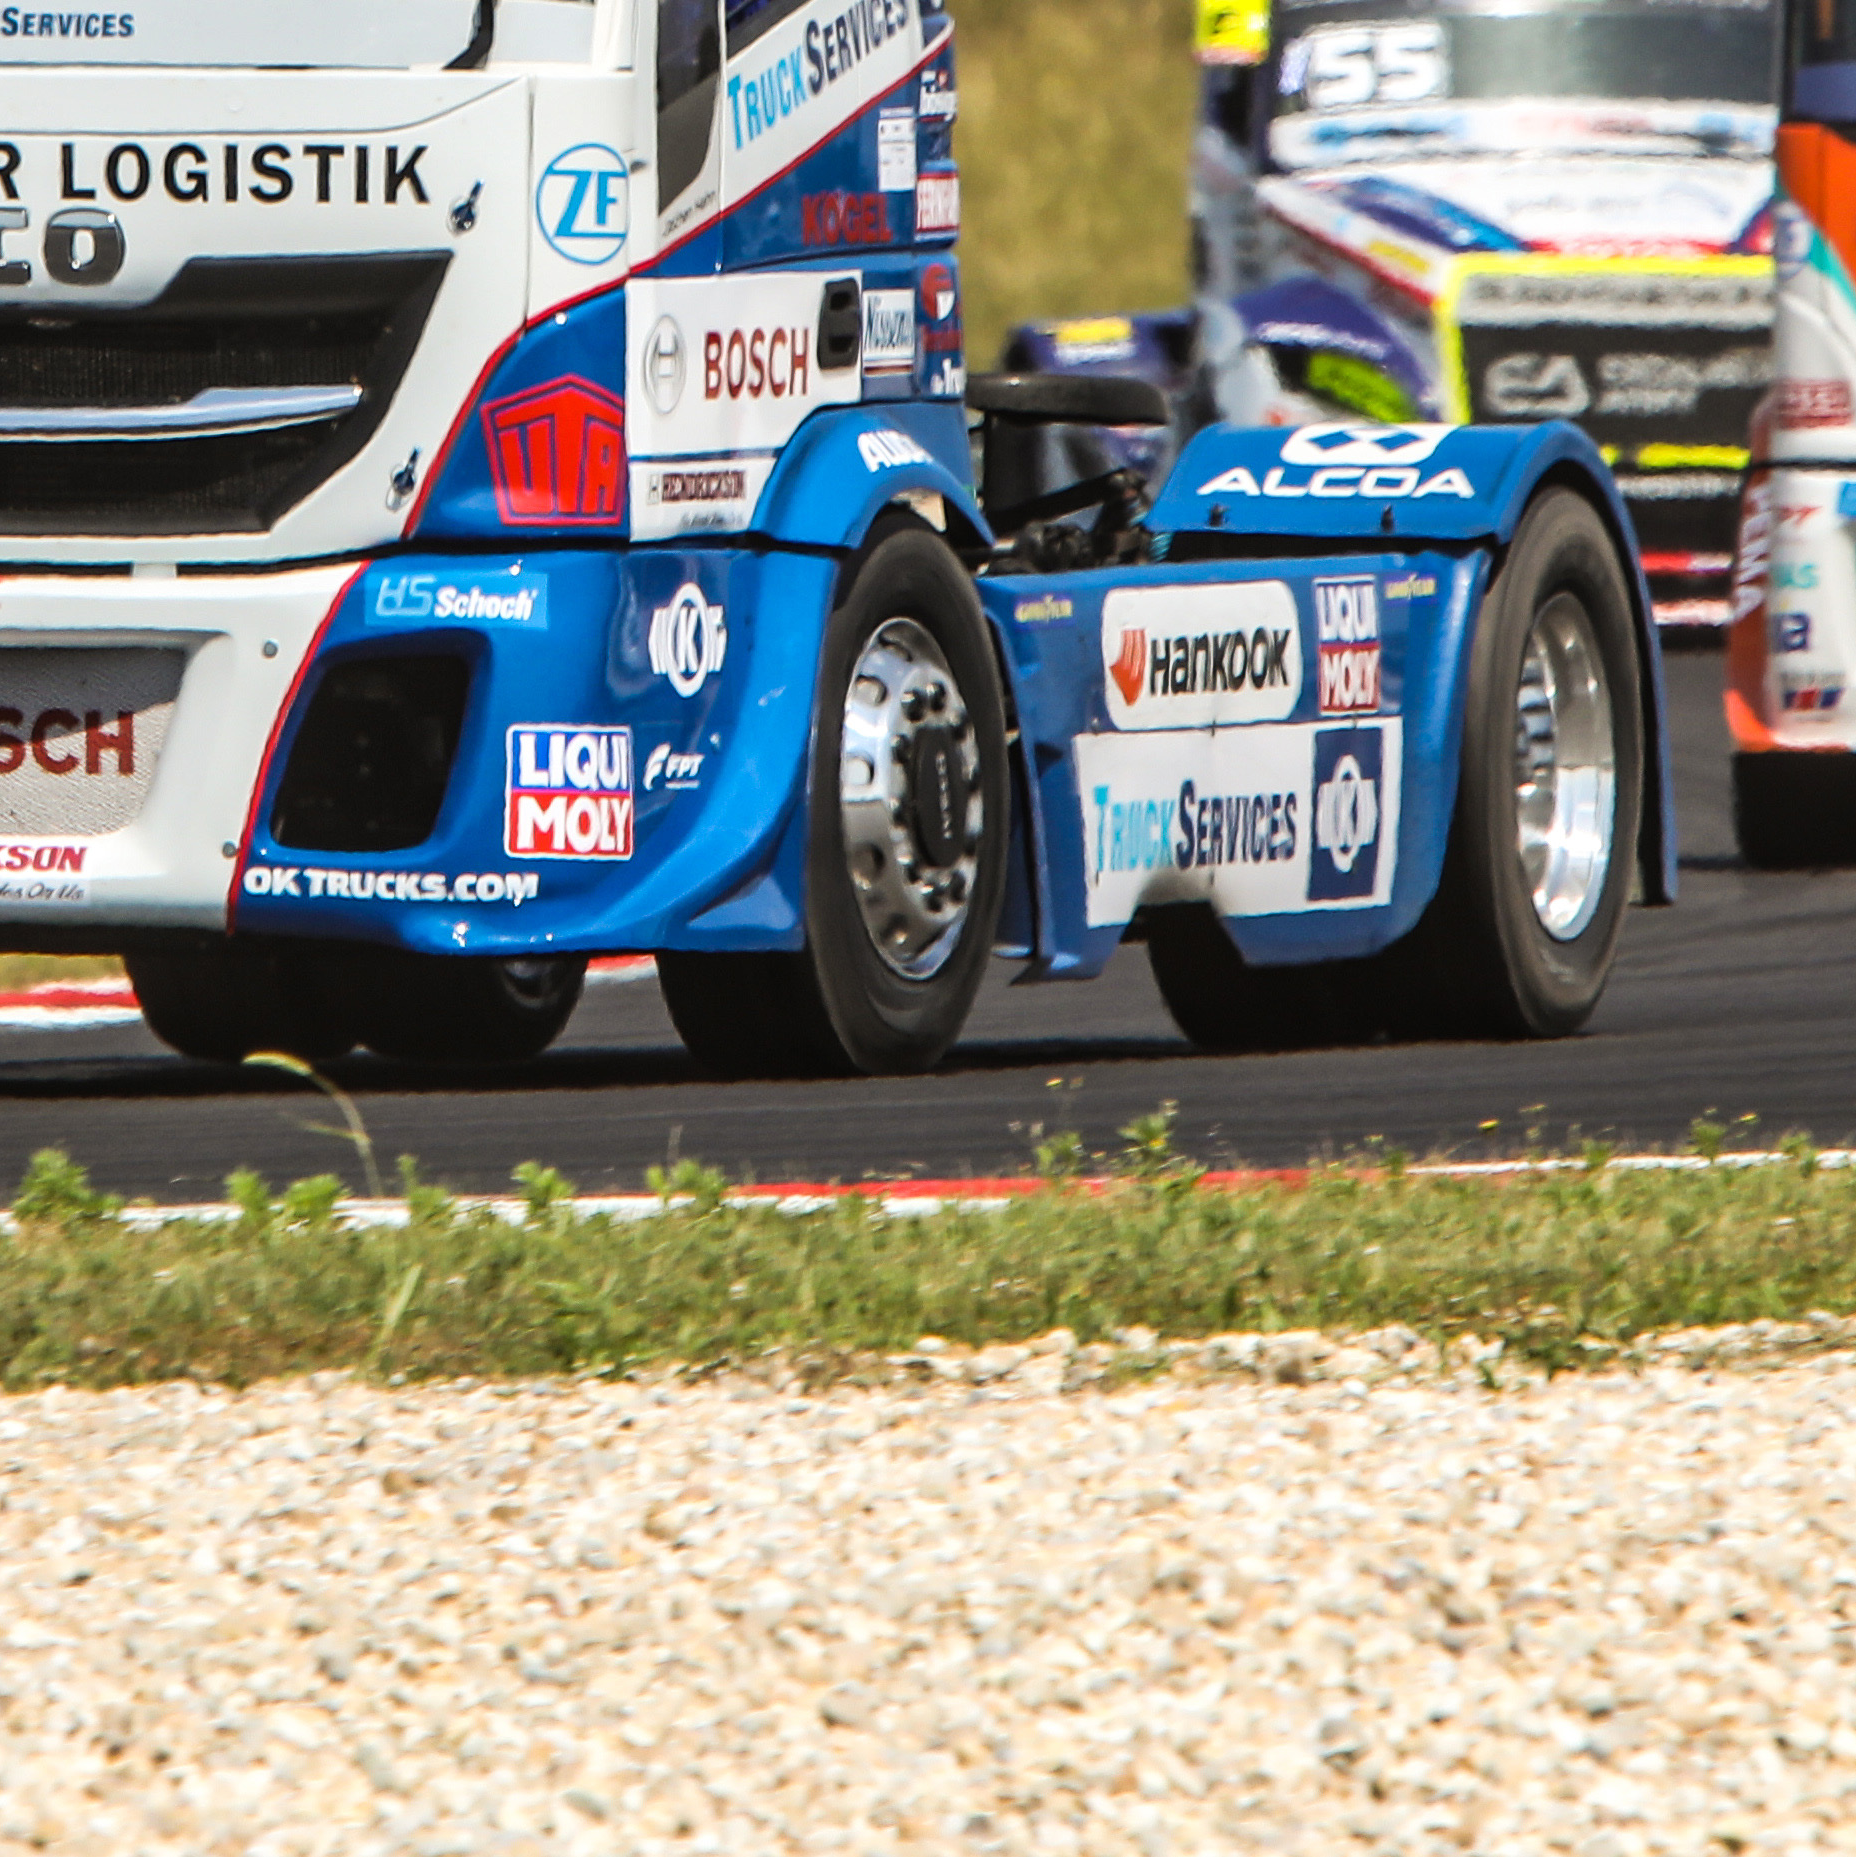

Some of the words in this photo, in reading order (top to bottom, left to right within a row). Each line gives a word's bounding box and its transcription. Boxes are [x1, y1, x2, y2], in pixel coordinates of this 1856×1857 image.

[1303, 22, 1449, 108] 55
[61, 143, 430, 204] LOGISTIK
[548, 170, 625, 238] ZF
[704, 326, 810, 401] BOSCH
[494, 388, 625, 514] UTA
[1196, 467, 1475, 498] ALCOA
[433, 587, 536, 621] Schoch
[1317, 584, 1376, 640] LIQUI
[1319, 649, 1379, 709] MOLY
[518, 734, 628, 788] LIQUI
[665, 752, 705, 778] FPT
[515, 796, 631, 850] MOLY
[244, 866, 307, 895] OK
[306, 868, 540, 902] TRUCKS.COM
